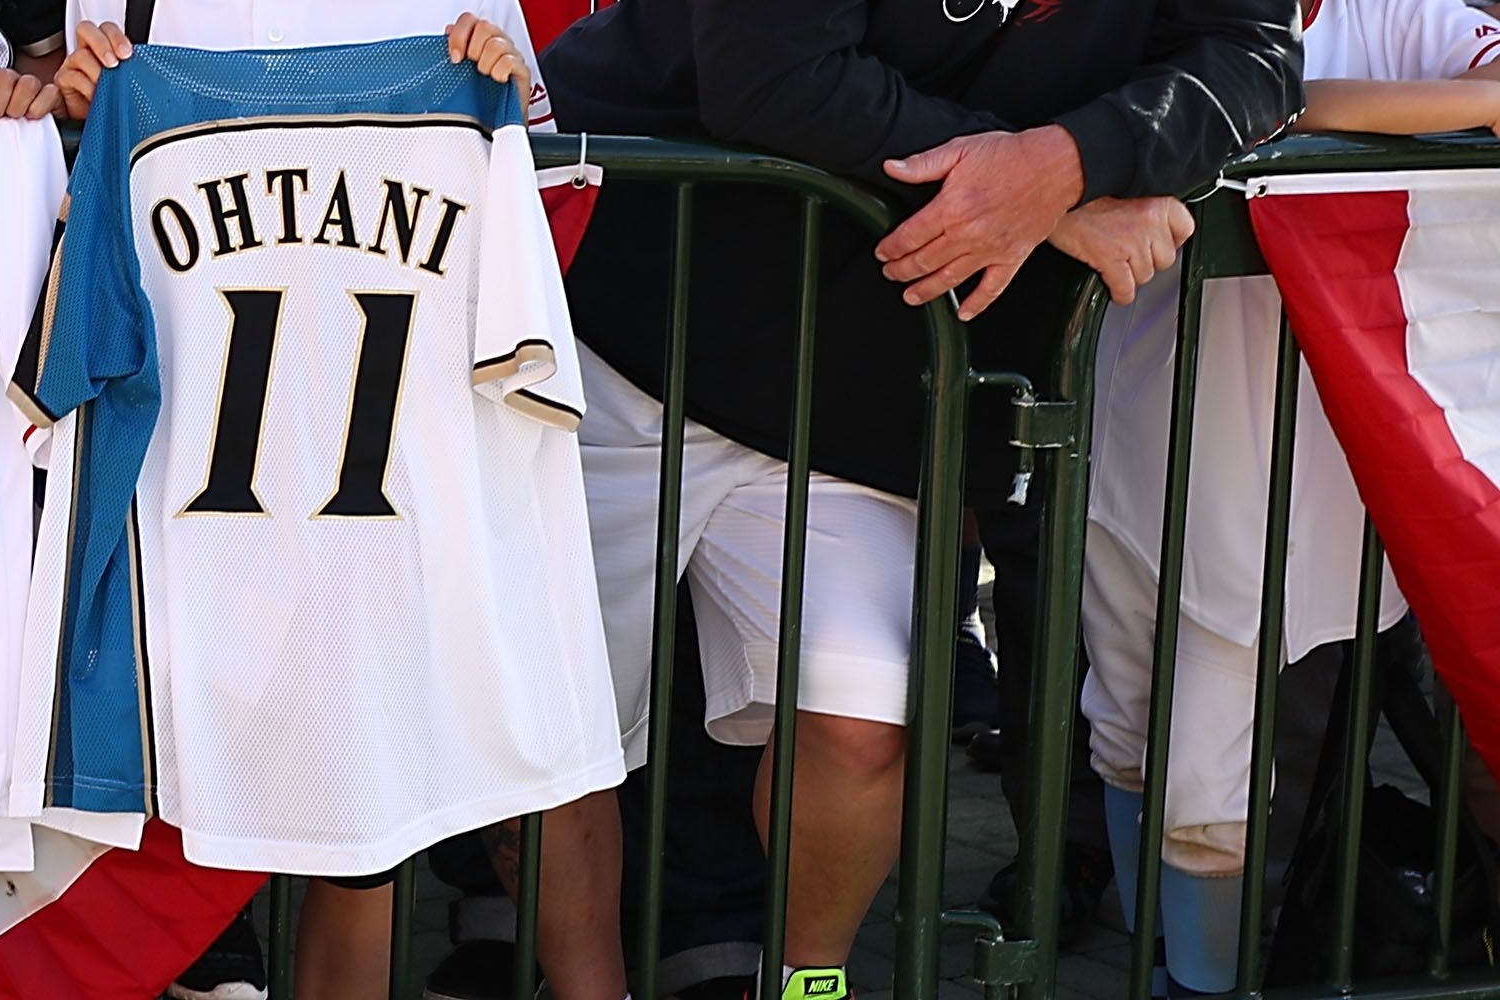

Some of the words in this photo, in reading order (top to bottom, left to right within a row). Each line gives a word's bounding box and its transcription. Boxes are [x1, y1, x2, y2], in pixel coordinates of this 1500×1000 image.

[150, 168, 468, 276] OHTANI
[174, 286, 422, 520] 11
[808, 979, 836, 993] NIKE
